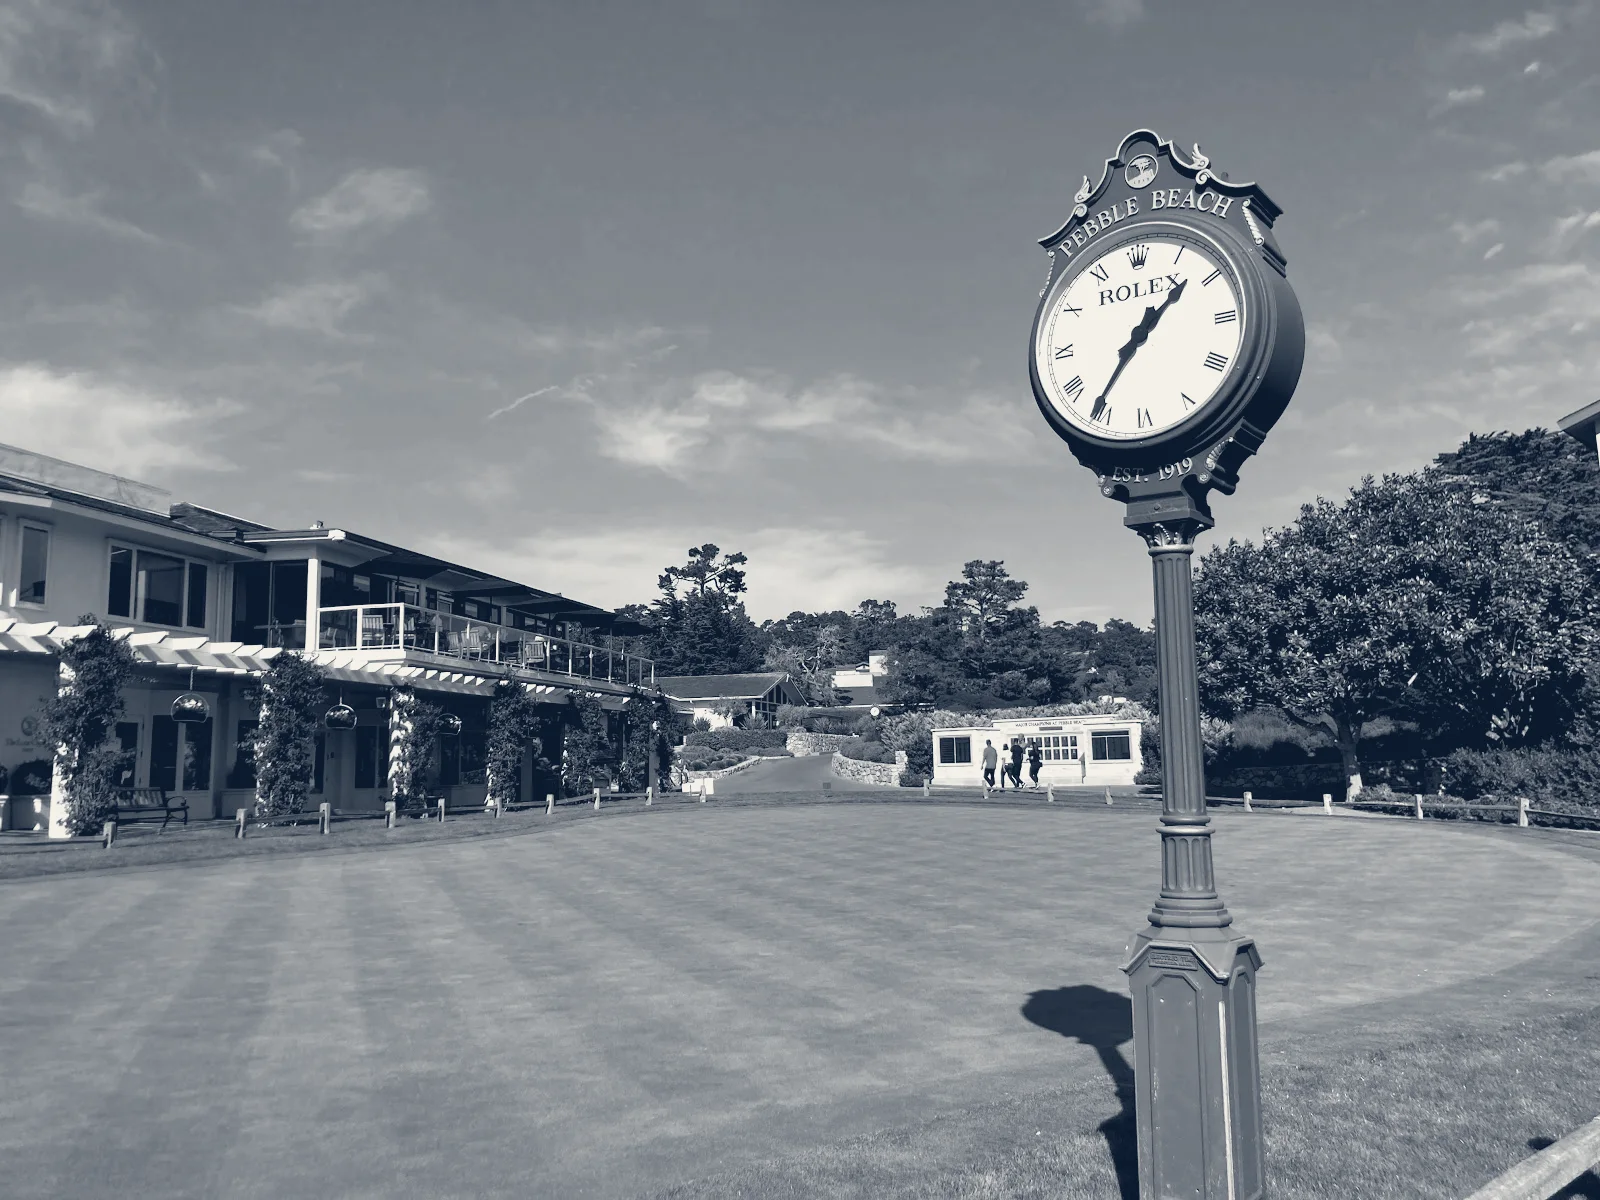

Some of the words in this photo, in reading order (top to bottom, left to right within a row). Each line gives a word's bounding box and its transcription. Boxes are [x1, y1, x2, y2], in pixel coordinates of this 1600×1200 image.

[1057, 196, 1140, 258] PEBBLE
[1150, 188, 1234, 219] BEACH
[1089, 263, 1109, 287] XI
[1098, 272, 1181, 306] ROLEX
[1063, 302, 1083, 318] X
[1111, 465, 1149, 484] EST.
[1157, 456, 1194, 481] 1919
